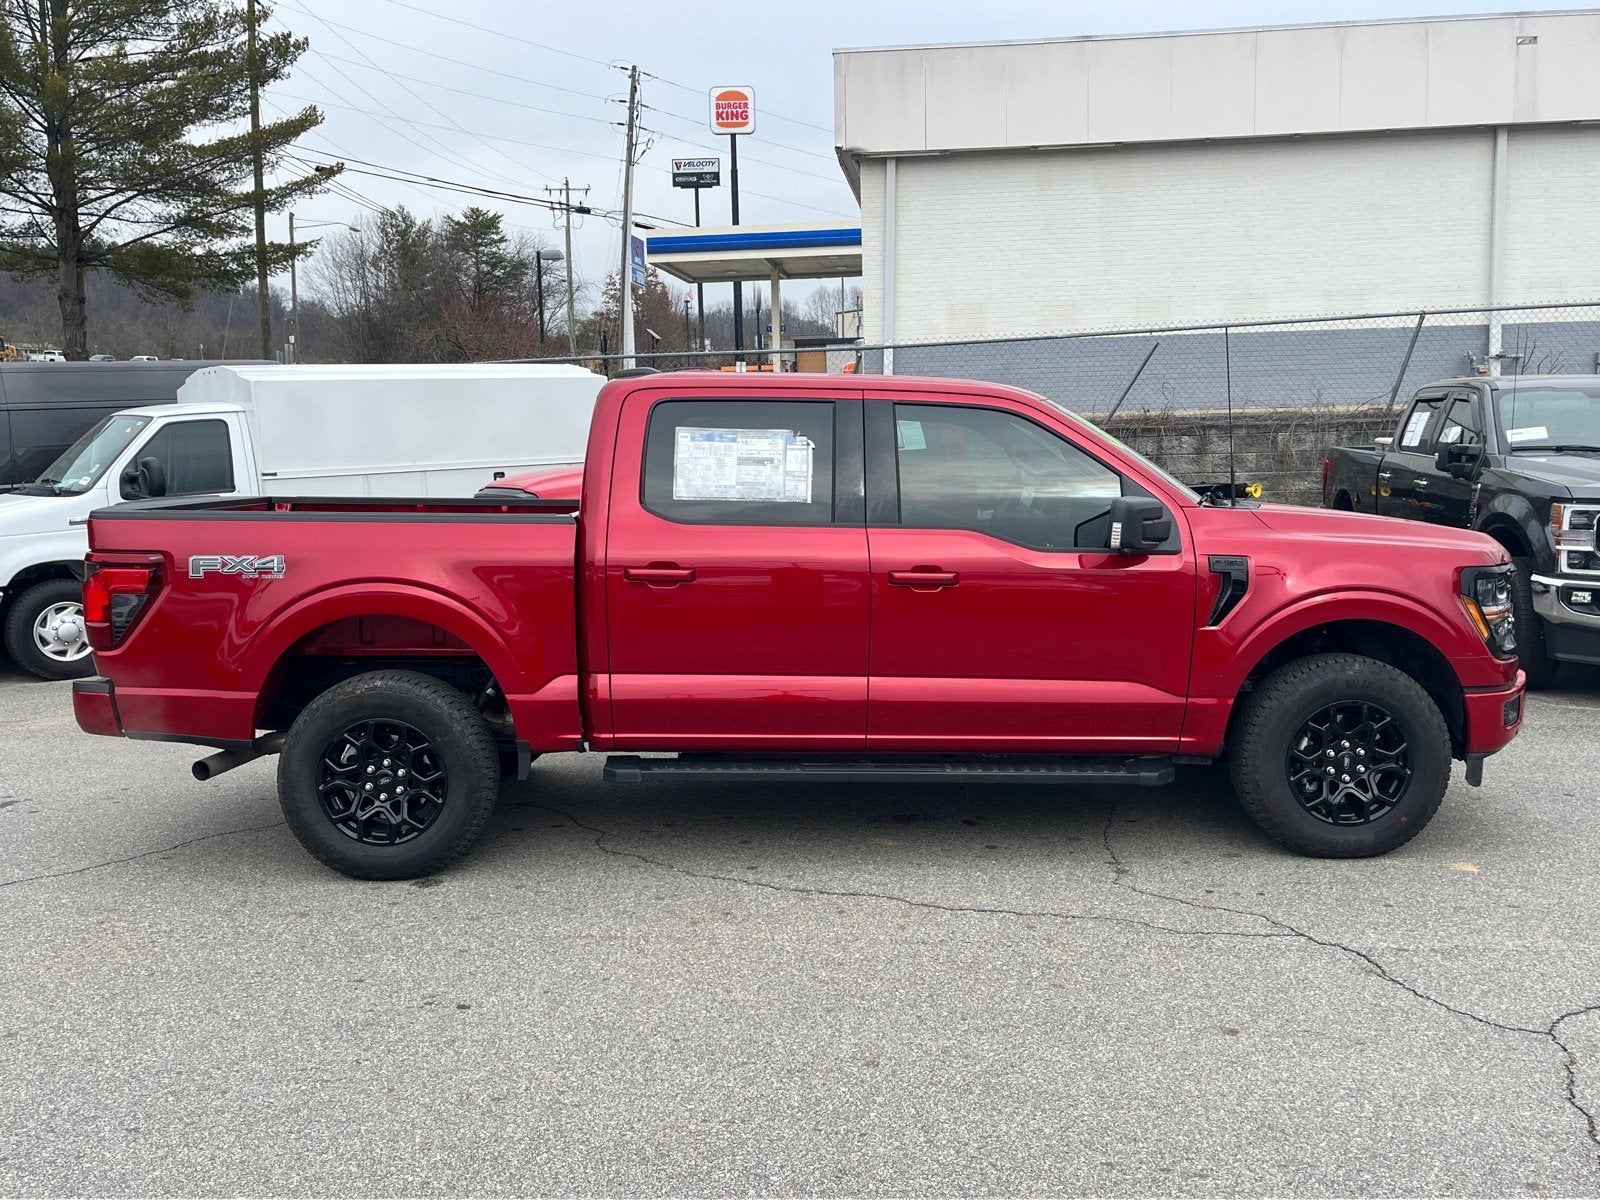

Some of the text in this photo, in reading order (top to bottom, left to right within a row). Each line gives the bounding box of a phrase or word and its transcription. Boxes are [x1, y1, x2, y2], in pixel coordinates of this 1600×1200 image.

[716, 102, 749, 110] BURGER
[716, 110, 749, 121] KING
[683, 160, 717, 168] VELOCITY
[188, 555, 285, 579] FX4
